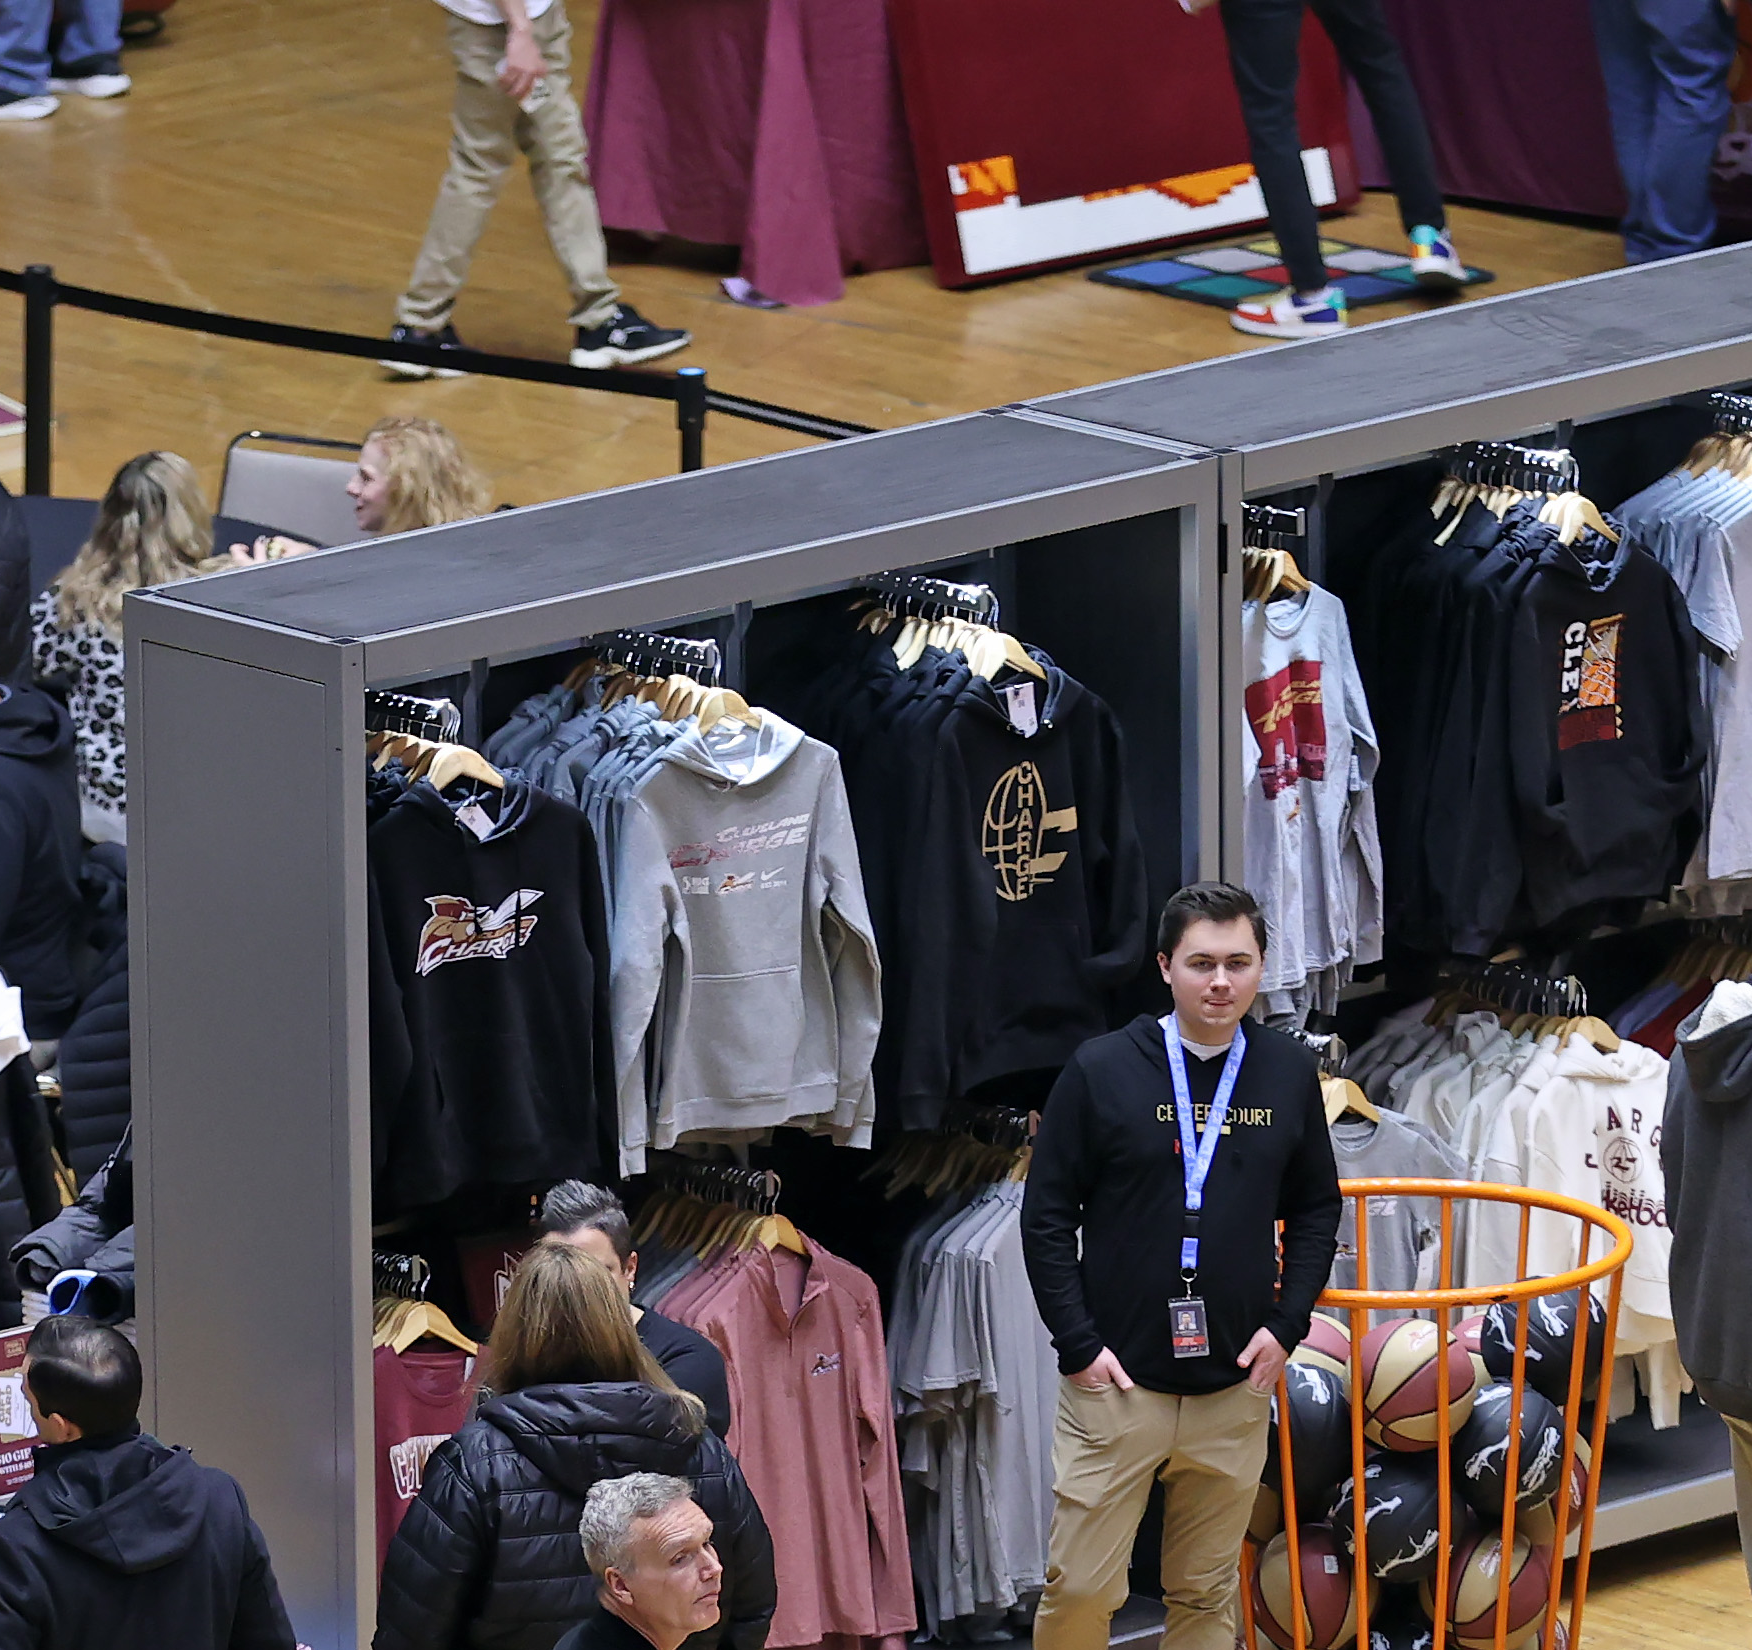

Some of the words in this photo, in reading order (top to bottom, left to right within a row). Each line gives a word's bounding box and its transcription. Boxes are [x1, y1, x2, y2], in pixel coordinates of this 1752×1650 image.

[1561, 621, 1588, 694] CLE
[1016, 761, 1034, 901] CHARGE
[12, 1447, 33, 1462] GIF
